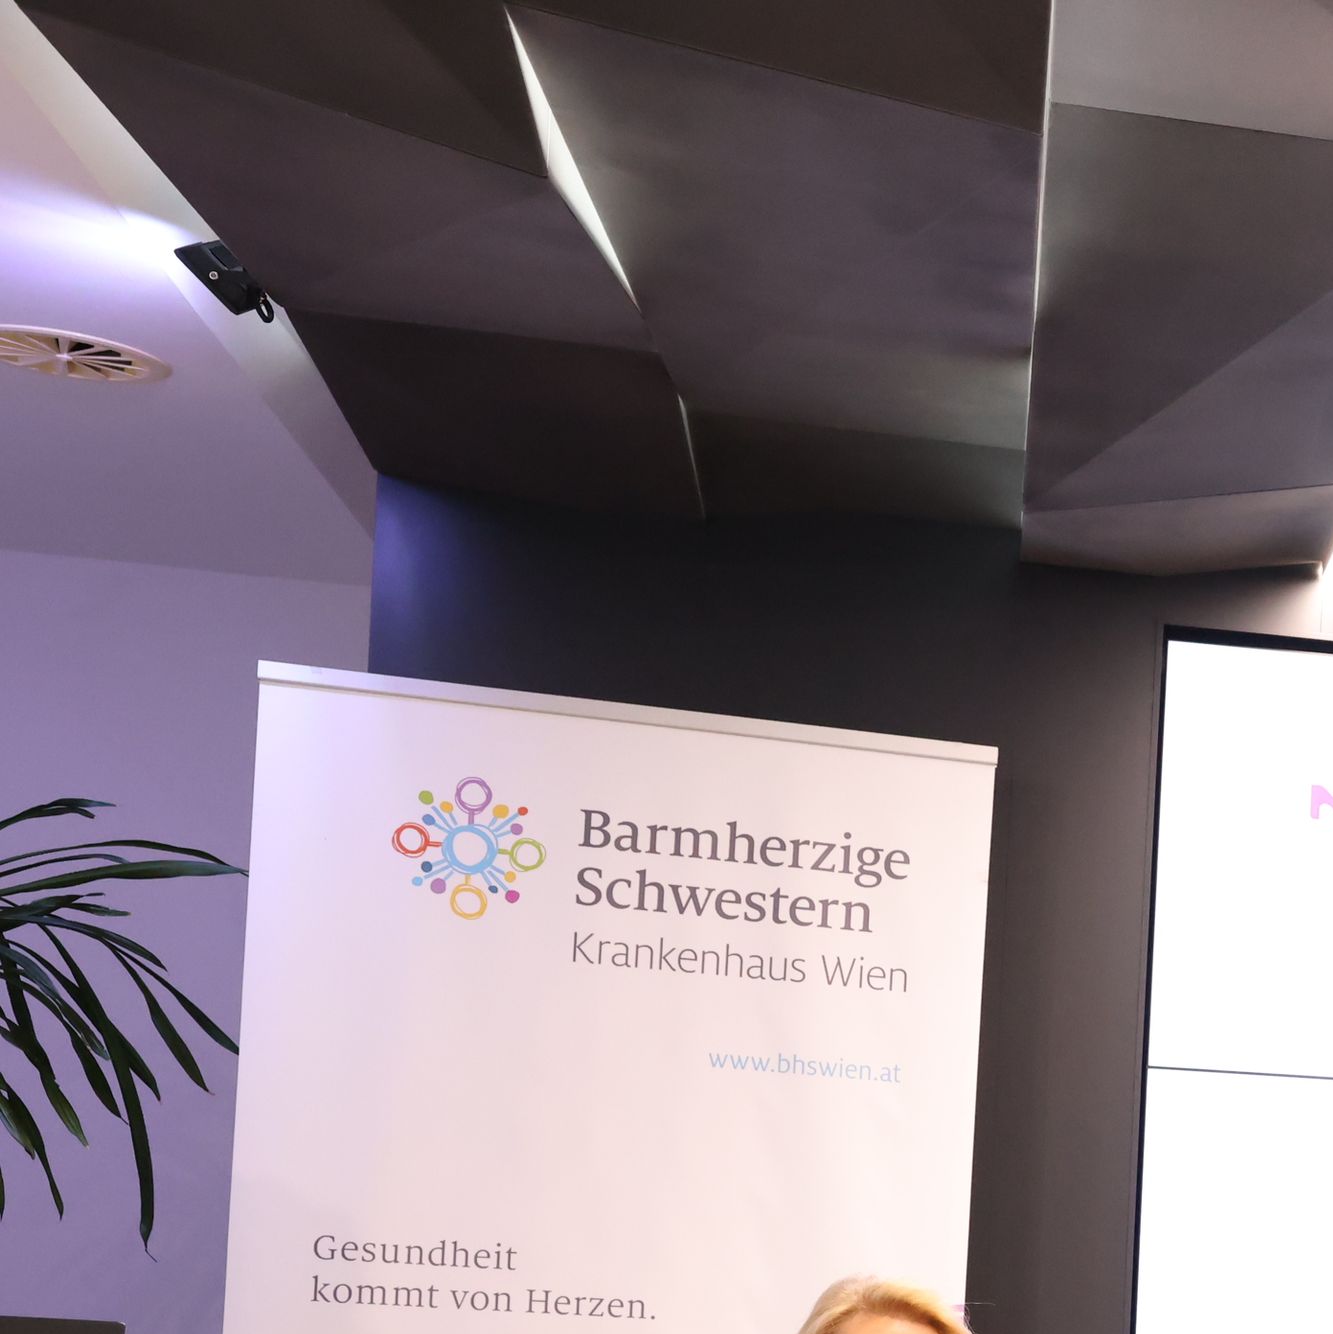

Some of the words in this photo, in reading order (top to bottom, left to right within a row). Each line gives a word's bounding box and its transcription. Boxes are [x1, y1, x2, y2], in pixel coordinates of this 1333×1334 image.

[577, 808, 911, 888] Barmherzige
[575, 867, 873, 934] Schwestern
[571, 930, 806, 984] Krankenhaus
[822, 955, 910, 993] Wien
[708, 1050, 902, 1084] www.bhswien.at
[312, 1234, 517, 1272] Gesundheit
[310, 1274, 440, 1309] kommt
[451, 1288, 513, 1314] von
[526, 1288, 656, 1321] Herzen.
